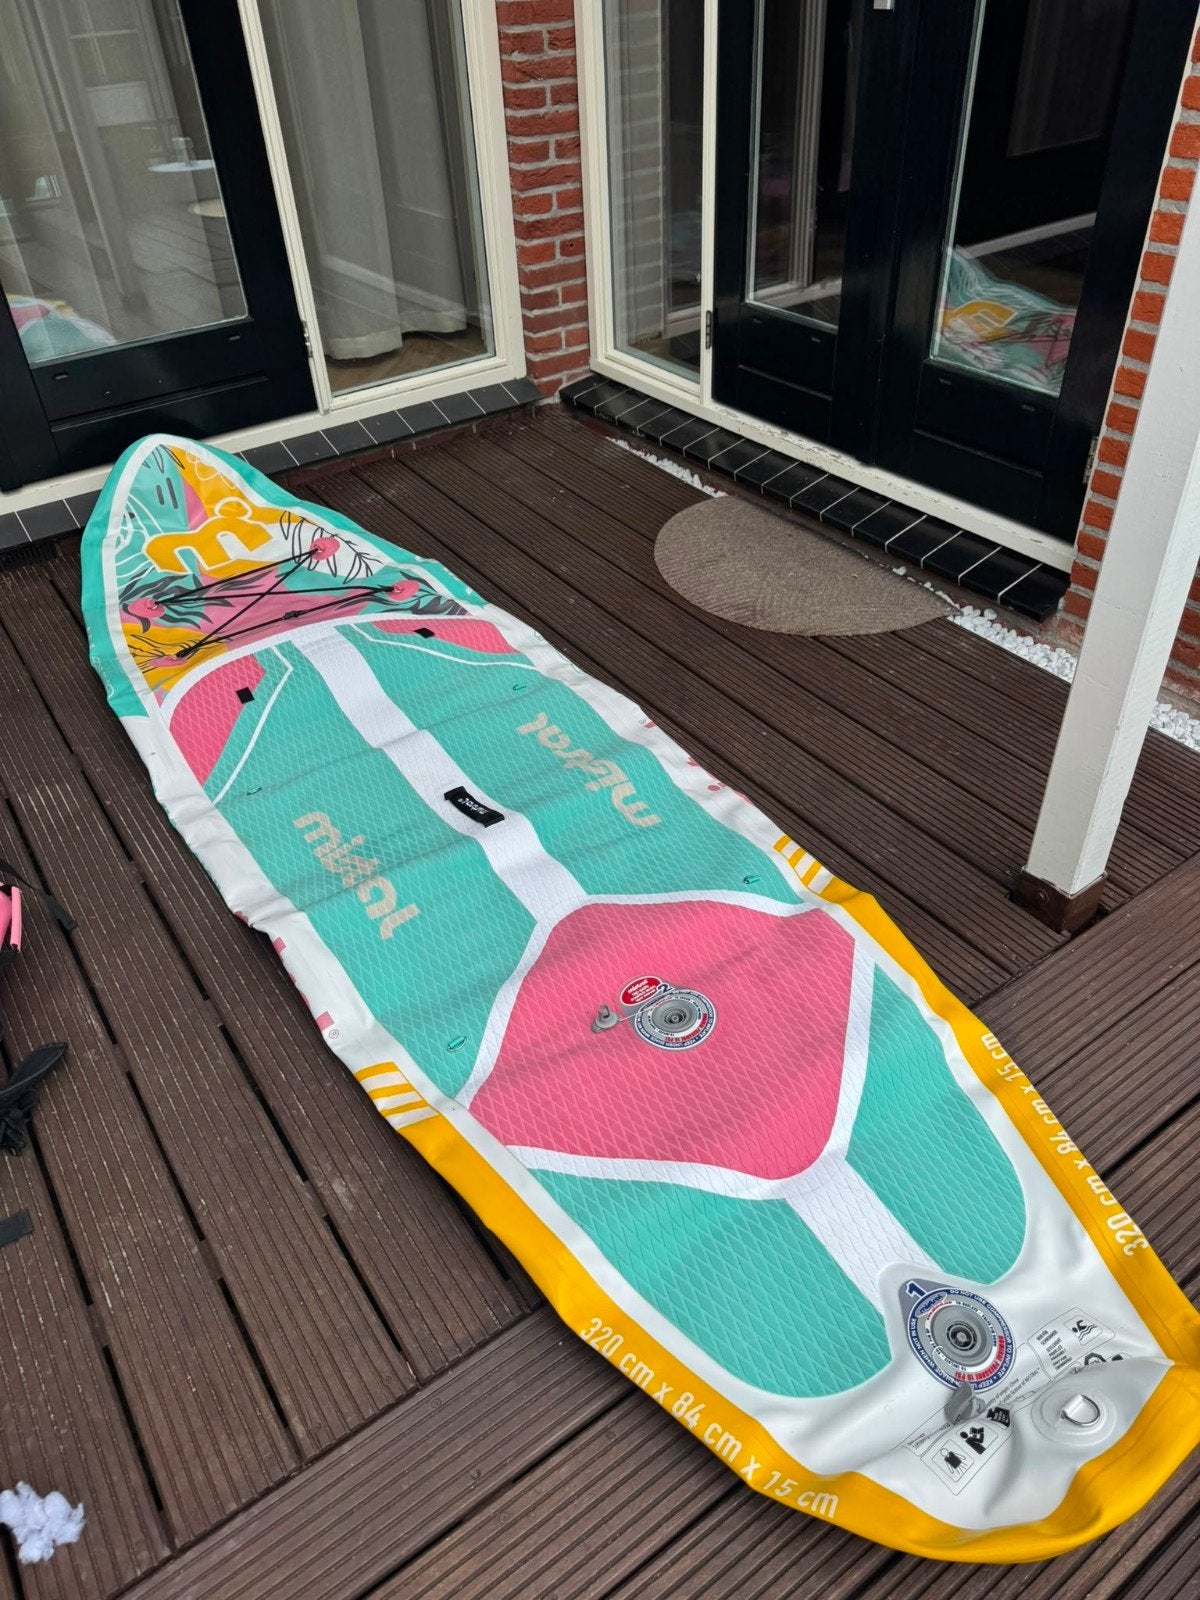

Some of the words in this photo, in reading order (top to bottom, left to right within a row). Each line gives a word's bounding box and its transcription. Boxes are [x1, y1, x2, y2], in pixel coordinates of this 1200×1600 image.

[516, 711, 662, 828] mistral
[293, 811, 420, 940] mistral
[657, 983, 674, 993] 2
[980, 1032, 1008, 1060] cm
[996, 1061, 1026, 1082] 15
[1020, 1084, 1037, 1095] x
[1031, 1098, 1059, 1125] cm
[1049, 1131, 1079, 1155] 84
[1073, 1158, 1090, 1170] x
[1086, 1175, 1118, 1206] cm
[1106, 1212, 1149, 1256] 320
[906, 1280, 927, 1298] 1
[919, 1294, 943, 1314] mistral
[910, 1317, 918, 1328] USE
[913, 1336, 924, 1351] NOT
[919, 1349, 936, 1369] WHEN
[997, 1354, 1012, 1377] INFLATE
[979, 1379, 994, 1388] KEEP
[580, 1318, 624, 1358] 320
[619, 1352, 655, 1389] cm
[652, 1381, 674, 1404] x
[671, 1391, 705, 1429] 84
[703, 1422, 743, 1462] cm
[740, 1455, 761, 1481] x
[761, 1471, 799, 1497] 15
[796, 1490, 839, 1518] cm
